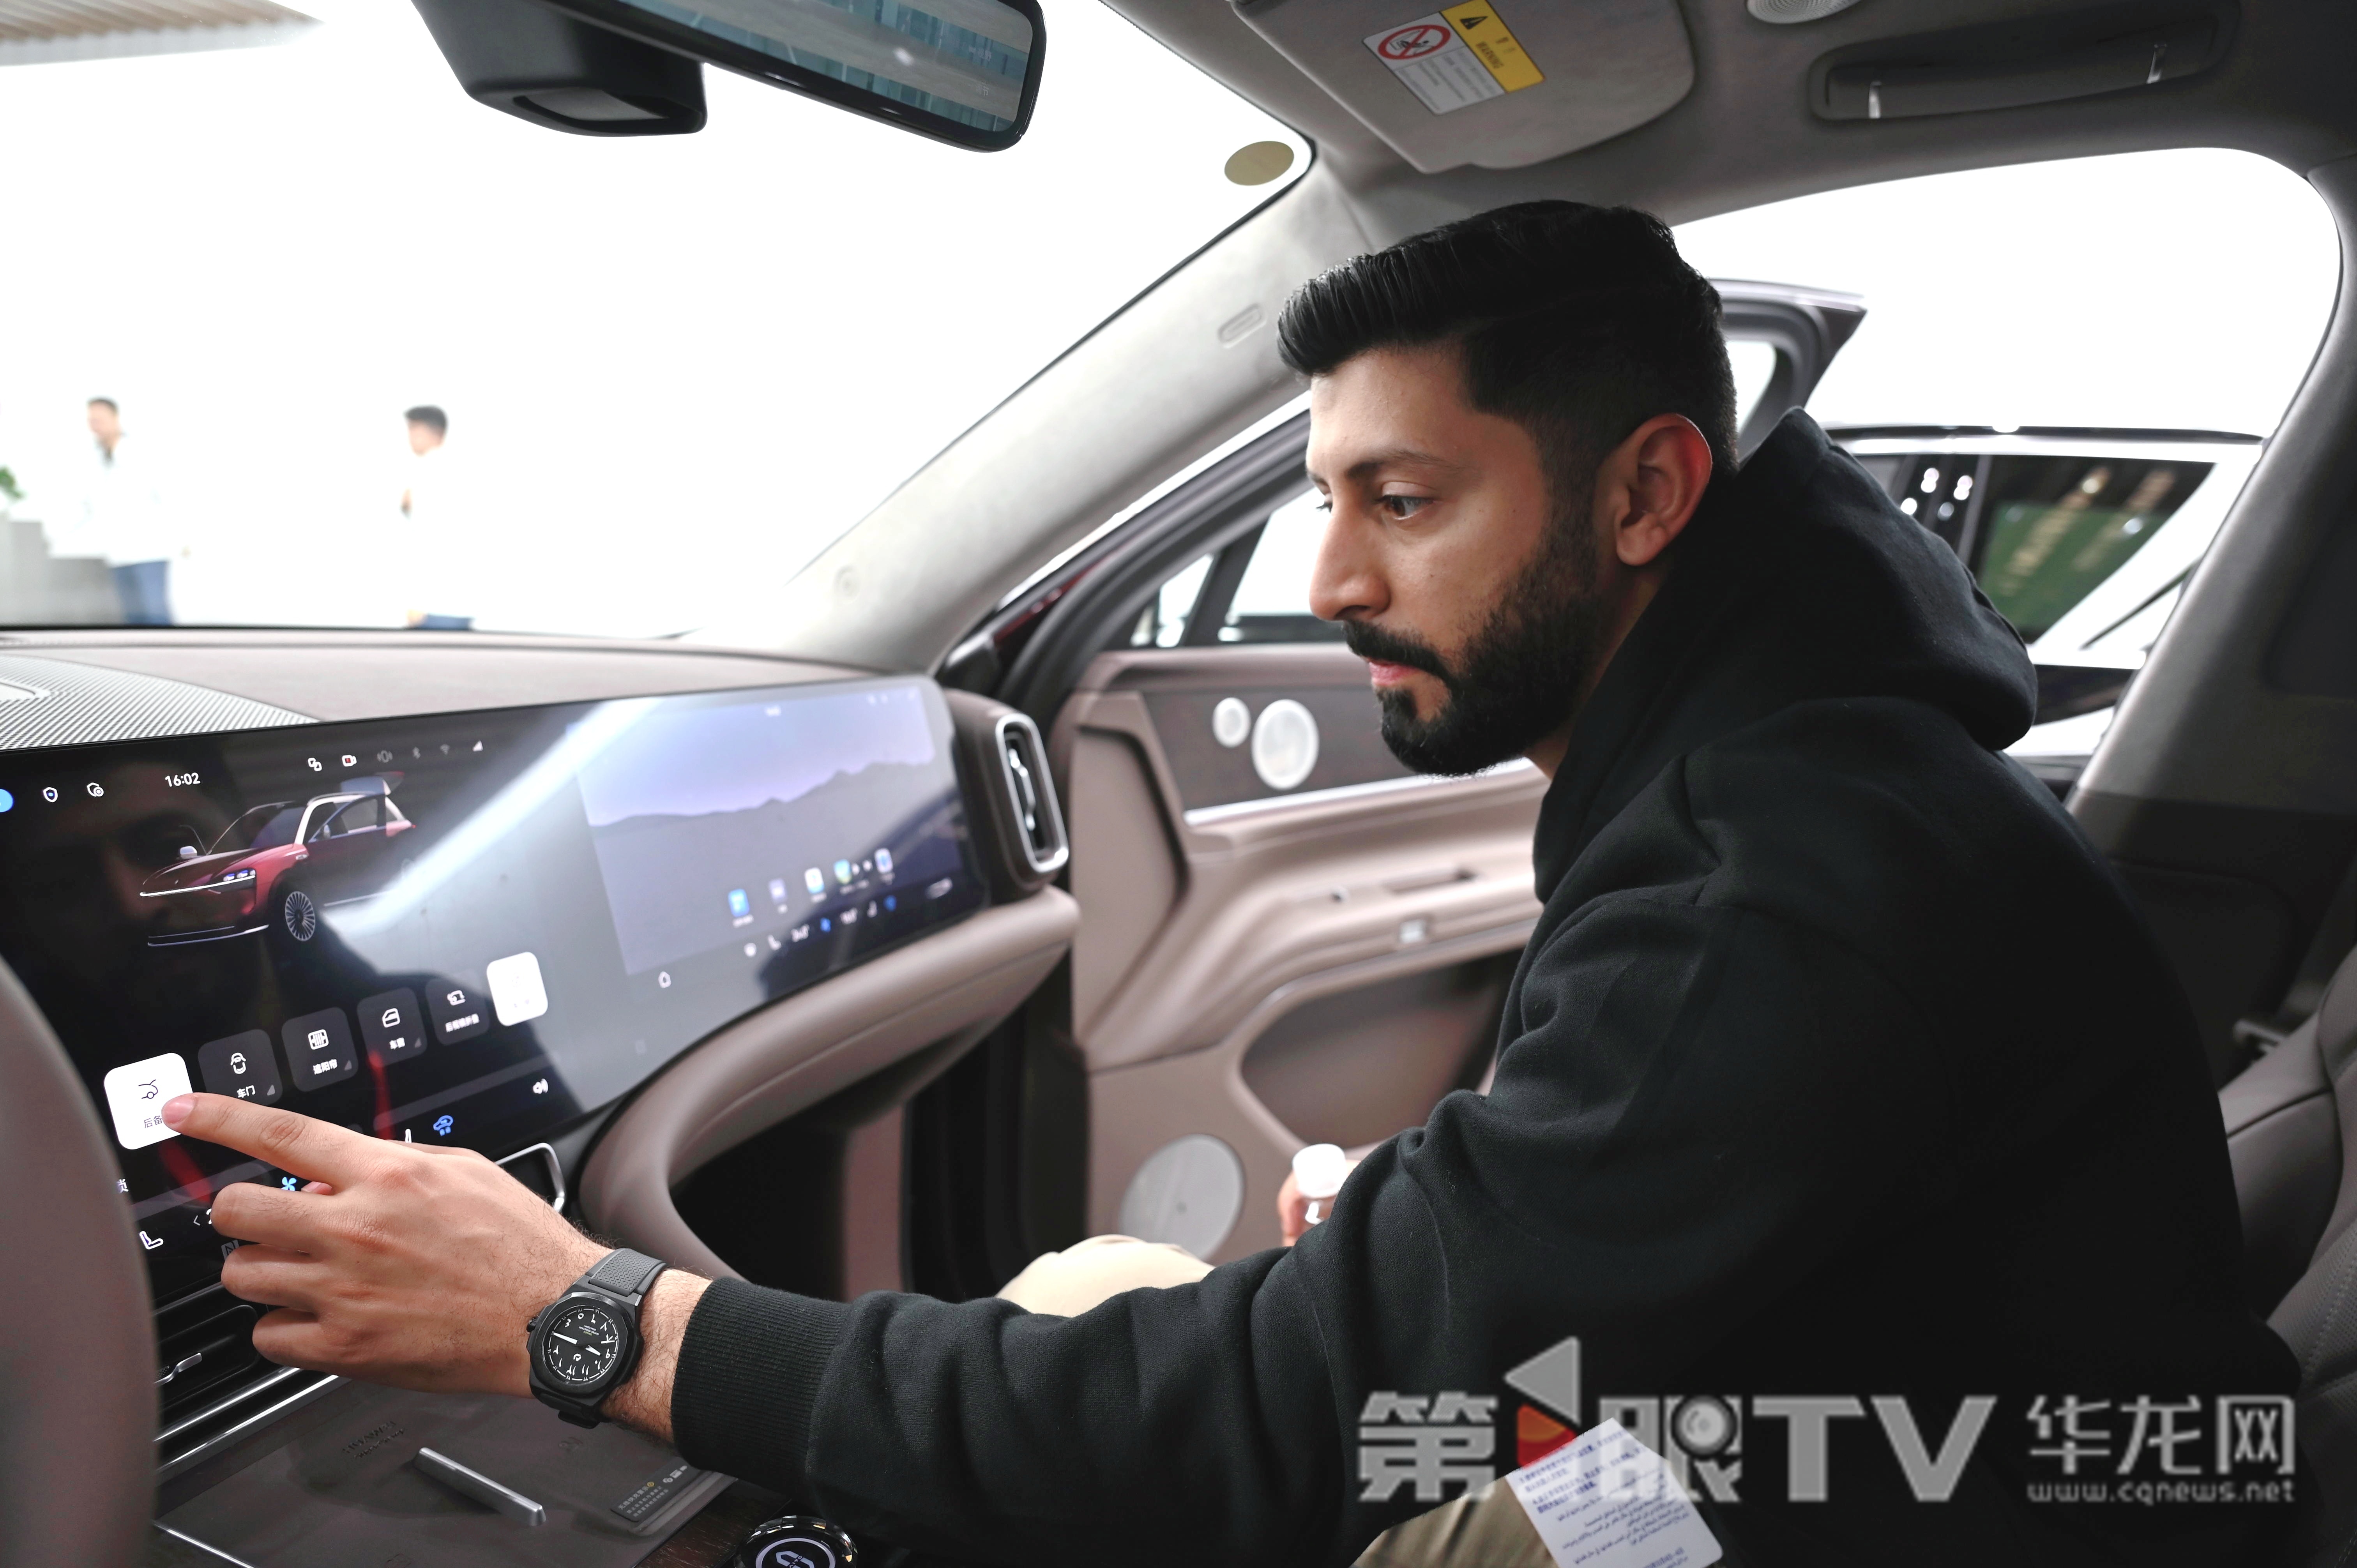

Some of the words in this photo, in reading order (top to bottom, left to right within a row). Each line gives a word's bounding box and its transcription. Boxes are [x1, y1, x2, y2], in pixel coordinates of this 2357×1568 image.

[165, 772, 200, 787] 16:02
[313, 1059, 337, 1075] 遮阳帘
[237, 1085, 256, 1098] 车门
[143, 1115, 163, 1128] 后备
[565, 1318, 571, 1328] ٤
[591, 1314, 596, 1324] ٦
[600, 1321, 607, 1331] ٧
[553, 1344, 559, 1355] ٢
[605, 1348, 611, 1359] ٩
[566, 1364, 576, 1376] ١٢
[582, 1364, 590, 1376] ١١
[594, 1360, 601, 1370] ١٠
